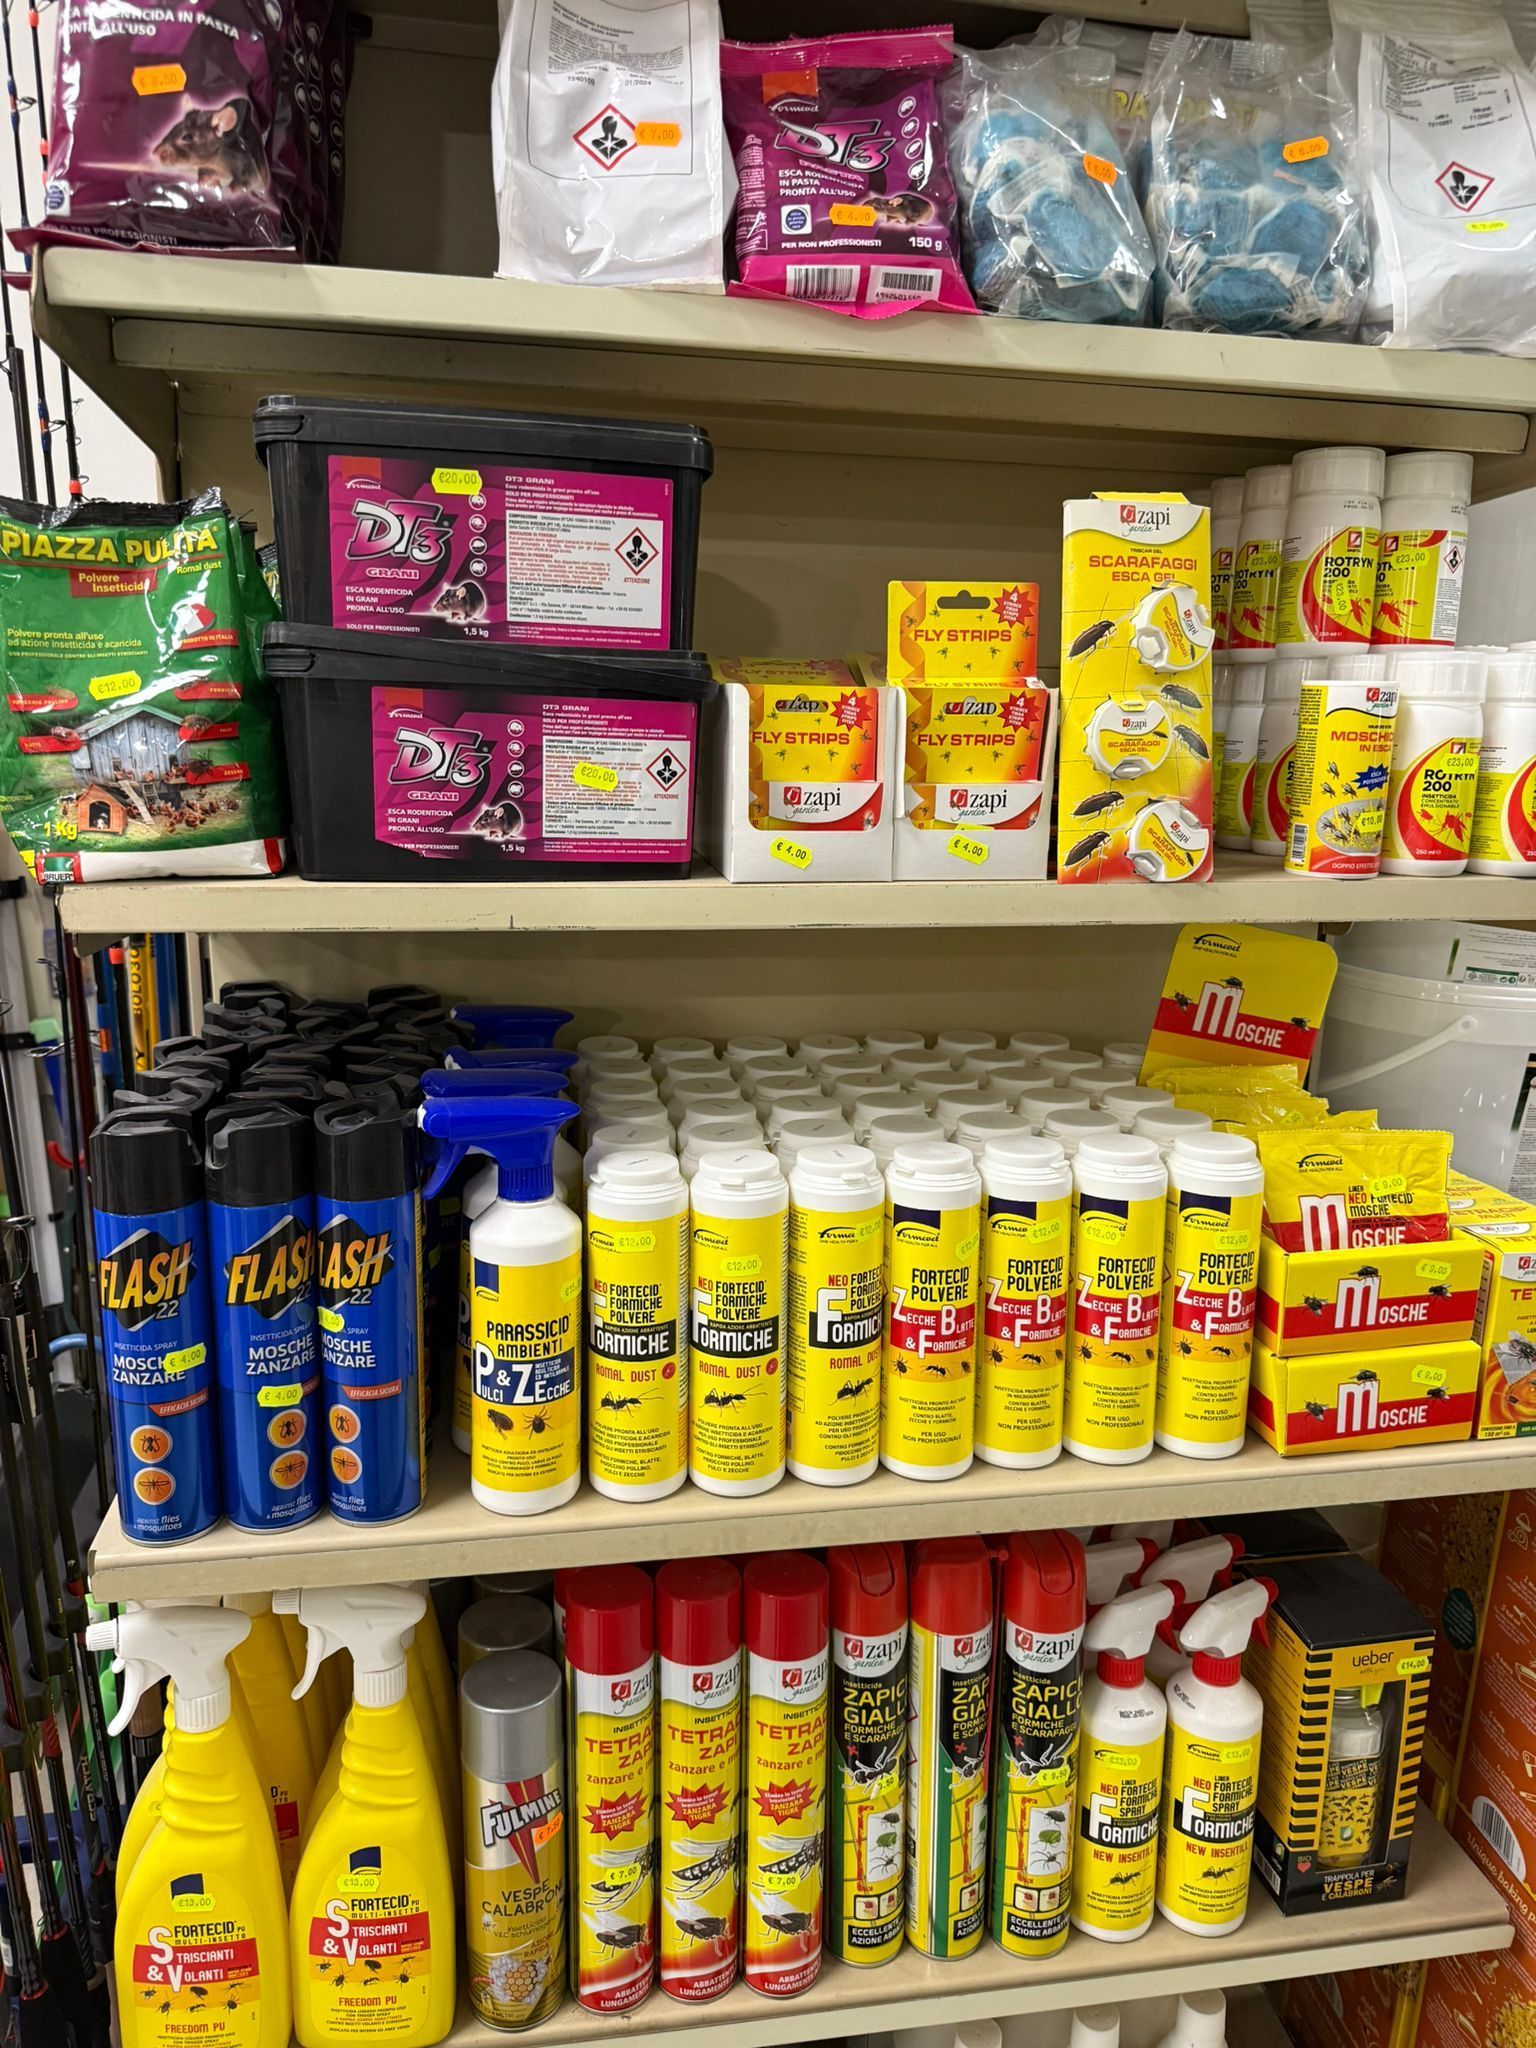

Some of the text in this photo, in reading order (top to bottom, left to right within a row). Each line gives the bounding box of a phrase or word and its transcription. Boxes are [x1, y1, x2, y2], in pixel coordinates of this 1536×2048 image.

[779, 178, 821, 187] IN PASTA
[780, 188, 857, 198] PRONTA ALL'USO
[781, 241, 796, 249] PER
[818, 239, 882, 248] PROFESSIONISTI
[908, 237, 942, 251] 150 g
[526, 477, 555, 485] GRANI
[345, 498, 452, 565] DT3
[1, 527, 219, 565] PIAZZA PULITA
[176, 560, 222, 575] Romal dust
[1089, 555, 1197, 571] SCARAFAGGI
[1324, 556, 1374, 569] ROTRYN
[78, 572, 120, 584] Polvere
[366, 567, 420, 580] GRANI
[1323, 568, 1351, 578] 200
[624, 577, 651, 585] ATTENZIONE
[346, 586, 414, 597] ESCA RODENTICIDA
[346, 604, 405, 614] PRONTA ALL'USO
[7, 628, 105, 640] Polvere pronta all'uso
[375, 624, 420, 633] PROFESSIONISTI
[913, 629, 1012, 642] FLY STRIPS
[8, 639, 20, 647] ad
[20, 638, 49, 648] azione
[51, 638, 98, 650] insetticida
[105, 639, 142, 650] acaricida
[542, 703, 590, 712] DT3 GRANI
[1129, 719, 1148, 731] zapi
[752, 732, 850, 745] FLY STRIPS
[917, 734, 1016, 747] FLY STRIPS
[1108, 741, 1160, 749] SCARAFAGGI
[1360, 744, 1371, 752] IN
[388, 727, 493, 788] DT3
[1422, 781, 1452, 792] 200
[408, 791, 460, 802] GRANI
[803, 787, 842, 812] zapi
[387, 808, 454, 817] ESCA RODENTICIDA
[44, 822, 78, 840] 1 Kg
[388, 825, 445, 834] PRONTA ALL'USO
[776, 842, 783, 852] €
[953, 839, 961, 849] €
[43, 872, 73, 882] BRUER
[1192, 980, 1286, 1049] MOSCHE
[1348, 1193, 1367, 1205] NEO
[1349, 1203, 1391, 1218] MOSCHE
[1007, 1255, 1064, 1276] FORTECID
[1097, 1255, 1156, 1274] FORTECID
[101, 1240, 194, 1310] FLASH
[828, 1274, 849, 1287] NEO
[911, 1266, 970, 1286] FORTECID
[593, 1278, 660, 1298] NEO FORTECID
[697, 1276, 766, 1295] NEO FORTECID
[350, 1288, 373, 1305] 22
[911, 1283, 969, 1303] POLVERE
[609, 1296, 663, 1312] FORMICHE
[715, 1292, 768, 1308] FORMICHE
[1335, 1276, 1430, 1329] MOSCHE
[155, 1299, 180, 1320] 22
[715, 1307, 761, 1321] POLVERE
[609, 1310, 656, 1325] POLVERE
[346, 1327, 369, 1336] SPRAY
[486, 1314, 570, 1343] PARASSICID
[1000, 1318, 1061, 1348] & FORMICHE
[1090, 1315, 1152, 1346] & FORMICHE
[114, 1340, 178, 1351] INSETTICIDA SPRAY
[249, 1333, 314, 1361] MOSCHE
[497, 1338, 563, 1359] AMBIENTI
[246, 1347, 316, 1375] ZANZARE
[830, 1355, 863, 1370] ROMAL
[475, 1340, 572, 1405] PULCI & ZECCHE
[595, 1363, 657, 1383] ROMAL DUST
[350, 1386, 401, 1399] EFFICACIA SICURA
[1336, 1379, 1428, 1435] MOSCHE
[902, 1434, 962, 1444] NON PROFESSIONALE
[161, 1515, 180, 1523] flies
[137, 1521, 182, 1533] mosquitoes
[1351, 1650, 1396, 1668] ueber
[843, 1679, 883, 1690] Insetticida
[778, 1806, 799, 1817] TIGRE
[1119, 1804, 1146, 1817] SPRAY
[1212, 1800, 1240, 1812] SPRAY
[480, 1787, 563, 1849] FULMINE
[690, 1811, 712, 1822] TIGRE
[610, 1819, 631, 1832] TIGRE
[1323, 1869, 1376, 1884] TRAPPOLA PER
[501, 1877, 550, 1904] VESPE
[1323, 1877, 1375, 1895] VESPE
[1321, 1887, 1373, 1901] E CALABRONI
[1497, 1871, 1528, 1915] baking
[350, 1894, 410, 1912] FORTECID
[351, 1907, 421, 1919] MULTI-INSETTO
[173, 1920, 236, 1939] FORTECID
[174, 1933, 247, 1946] MULTI-INSETTO
[851, 1932, 883, 1945] AZIONE
[338, 1995, 398, 2007] FREEDOM PU
[165, 2022, 226, 2034] FREEDOM PU
